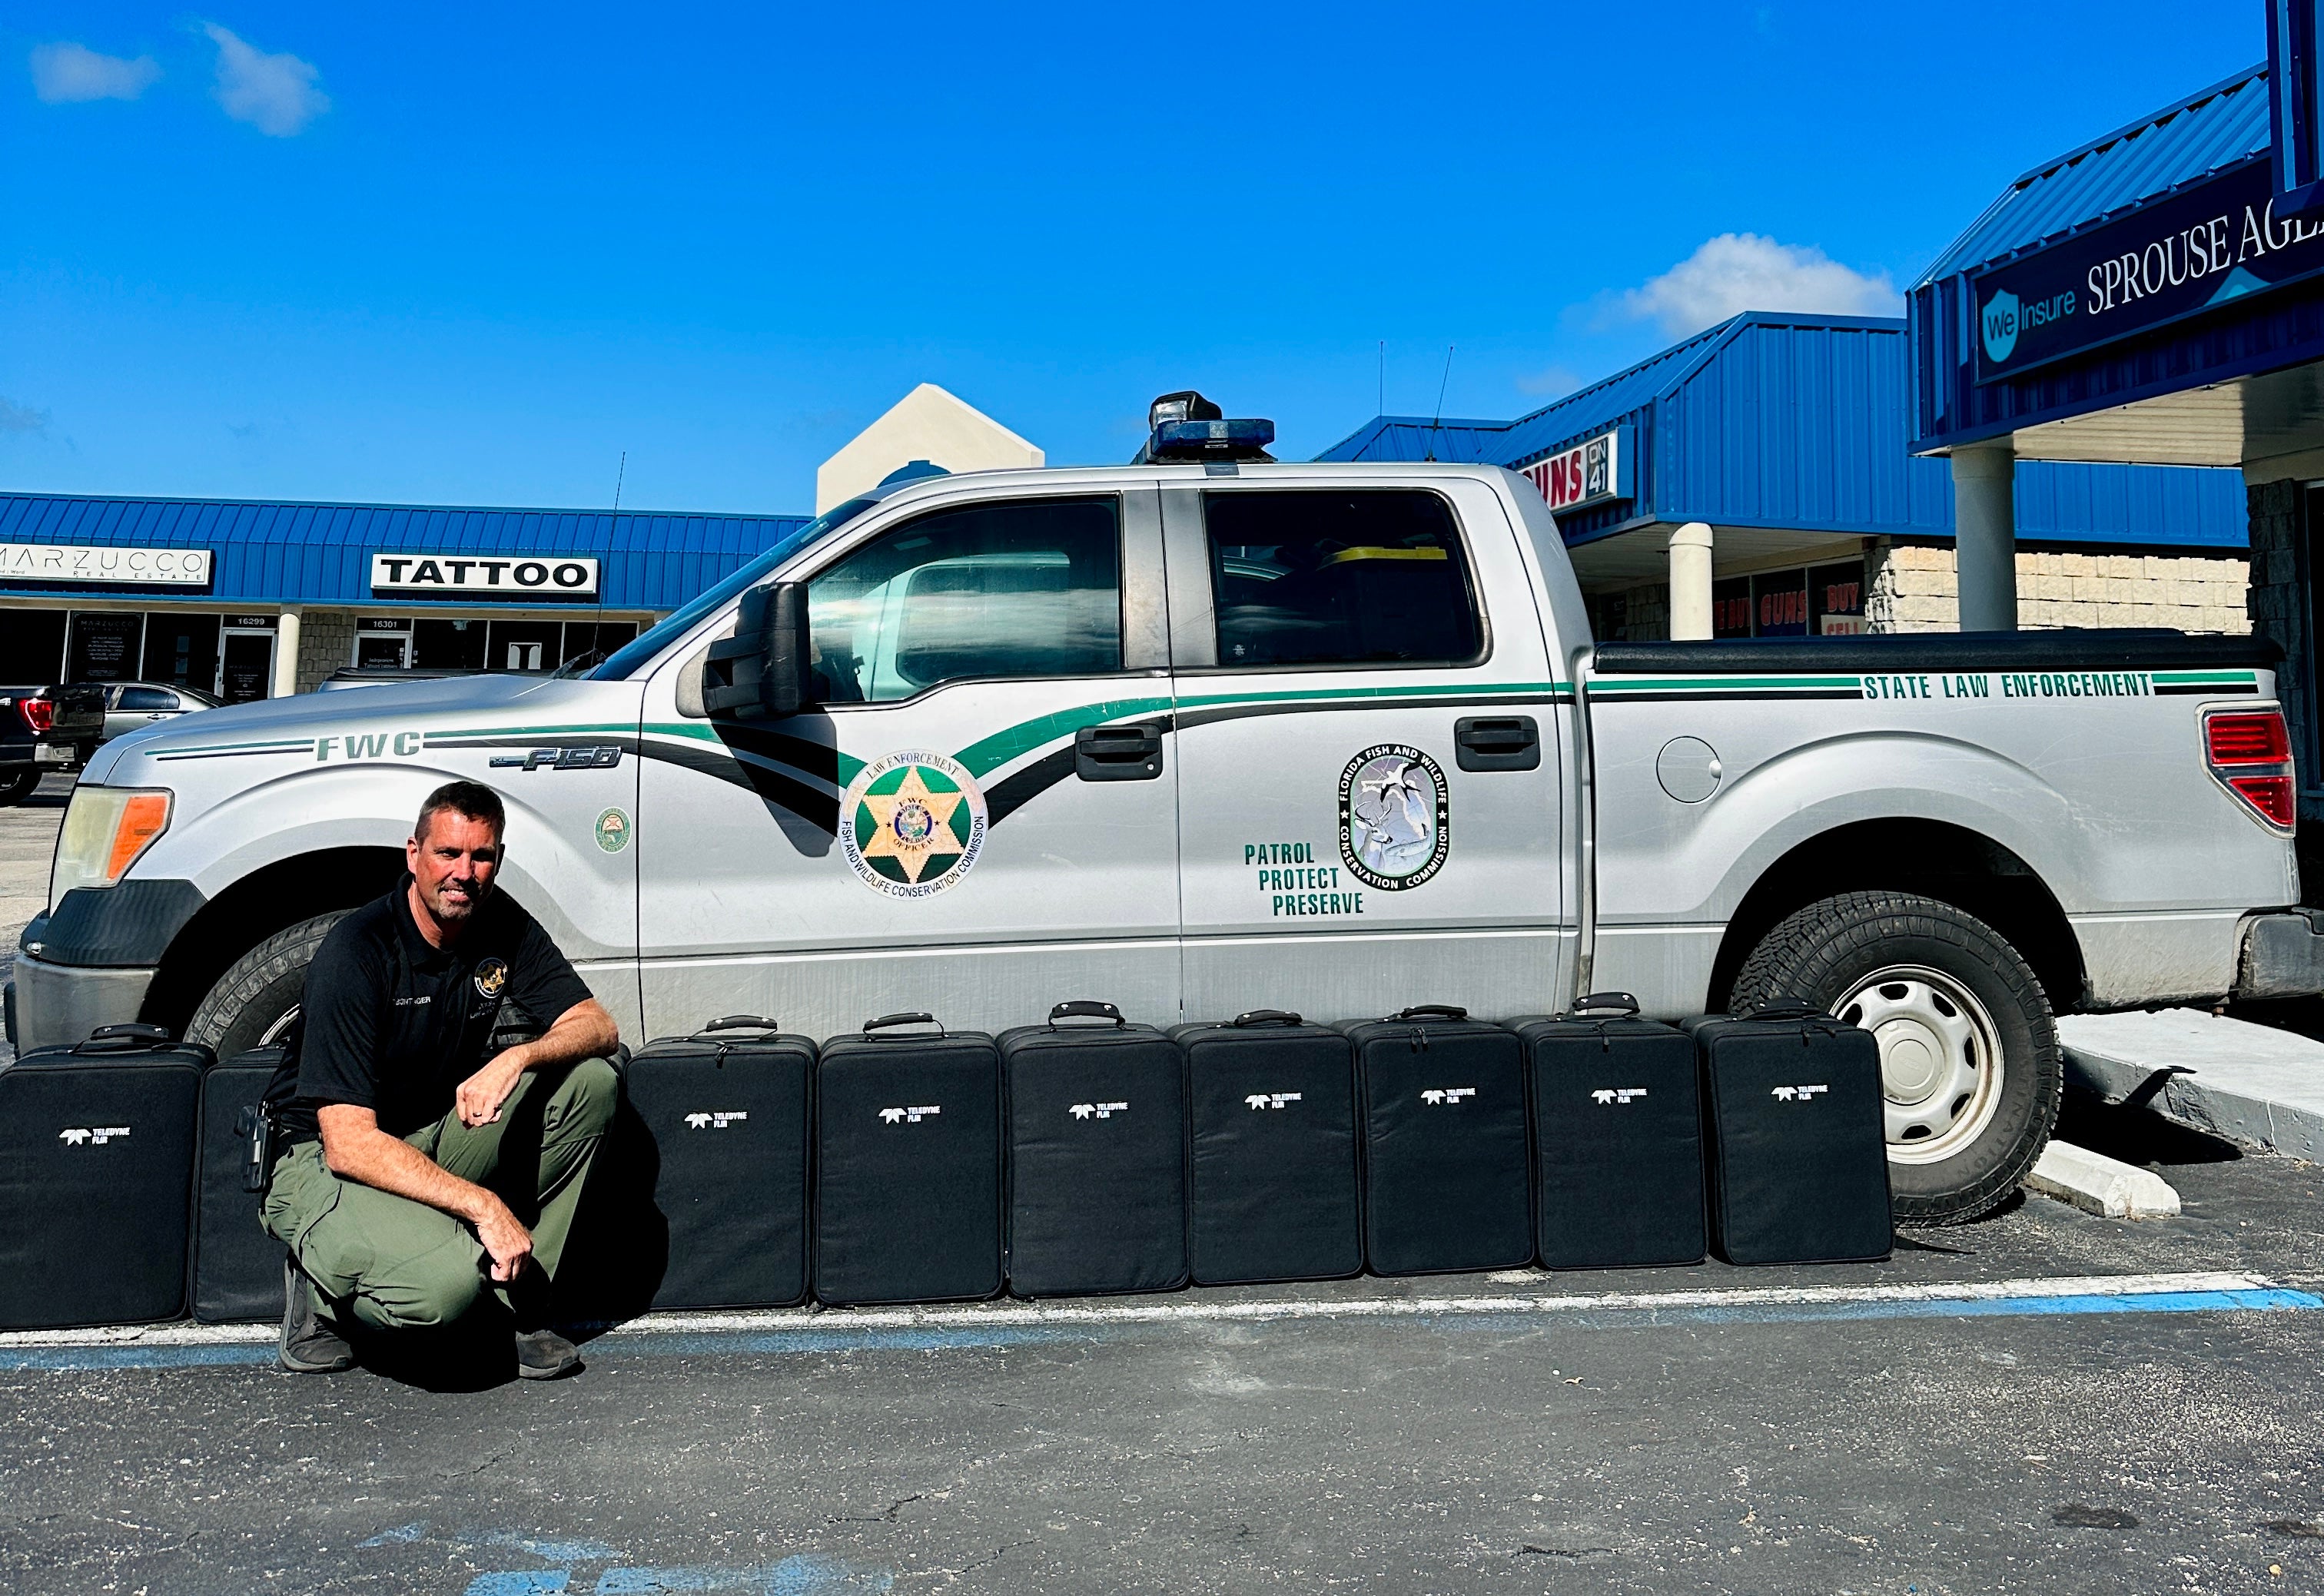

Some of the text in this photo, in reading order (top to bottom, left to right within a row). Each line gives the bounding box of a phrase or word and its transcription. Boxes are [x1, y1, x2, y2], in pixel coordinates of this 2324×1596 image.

[2087, 197, 2324, 316] SPROUSE AG
[1987, 290, 2076, 341] We Insure
[1589, 440, 1606, 464] ON
[1522, 450, 1582, 508] UNS
[1589, 463, 1606, 493] 41
[380, 559, 589, 588] TATTOO
[1761, 589, 1806, 626] GUNS
[1827, 582, 1859, 612] BUY
[1864, 672, 2152, 699] STATE LAW ENFORCEMENT
[317, 731, 420, 762] FWC
[865, 752, 960, 780] LAW ENFORCEMENT
[1339, 745, 1448, 804] FLORIDA FISH AND WILDLIFE
[842, 815, 984, 898] FISH AND WILDLIFE CONSERVATION COMMISSION
[1244, 842, 1315, 865] PATROL
[1340, 825, 1448, 889] CONSERVATION COMMISSION
[1259, 867, 1340, 891] PROTECT
[1273, 892, 1364, 917] PRESERVE
[1270, 1092, 1302, 1101] TELEDYNE
[1446, 1087, 1476, 1097] TELEDYNE
[1616, 1088, 1648, 1097] TELEDYNE
[1797, 1084, 1828, 1093] TELEDYNE
[713, 1111, 748, 1120] TELEDYNE
[907, 1105, 941, 1114] TELEDYNE
[1096, 1102, 1128, 1111] TELEDYNE
[92, 1126, 131, 1136] TELEDYNE
